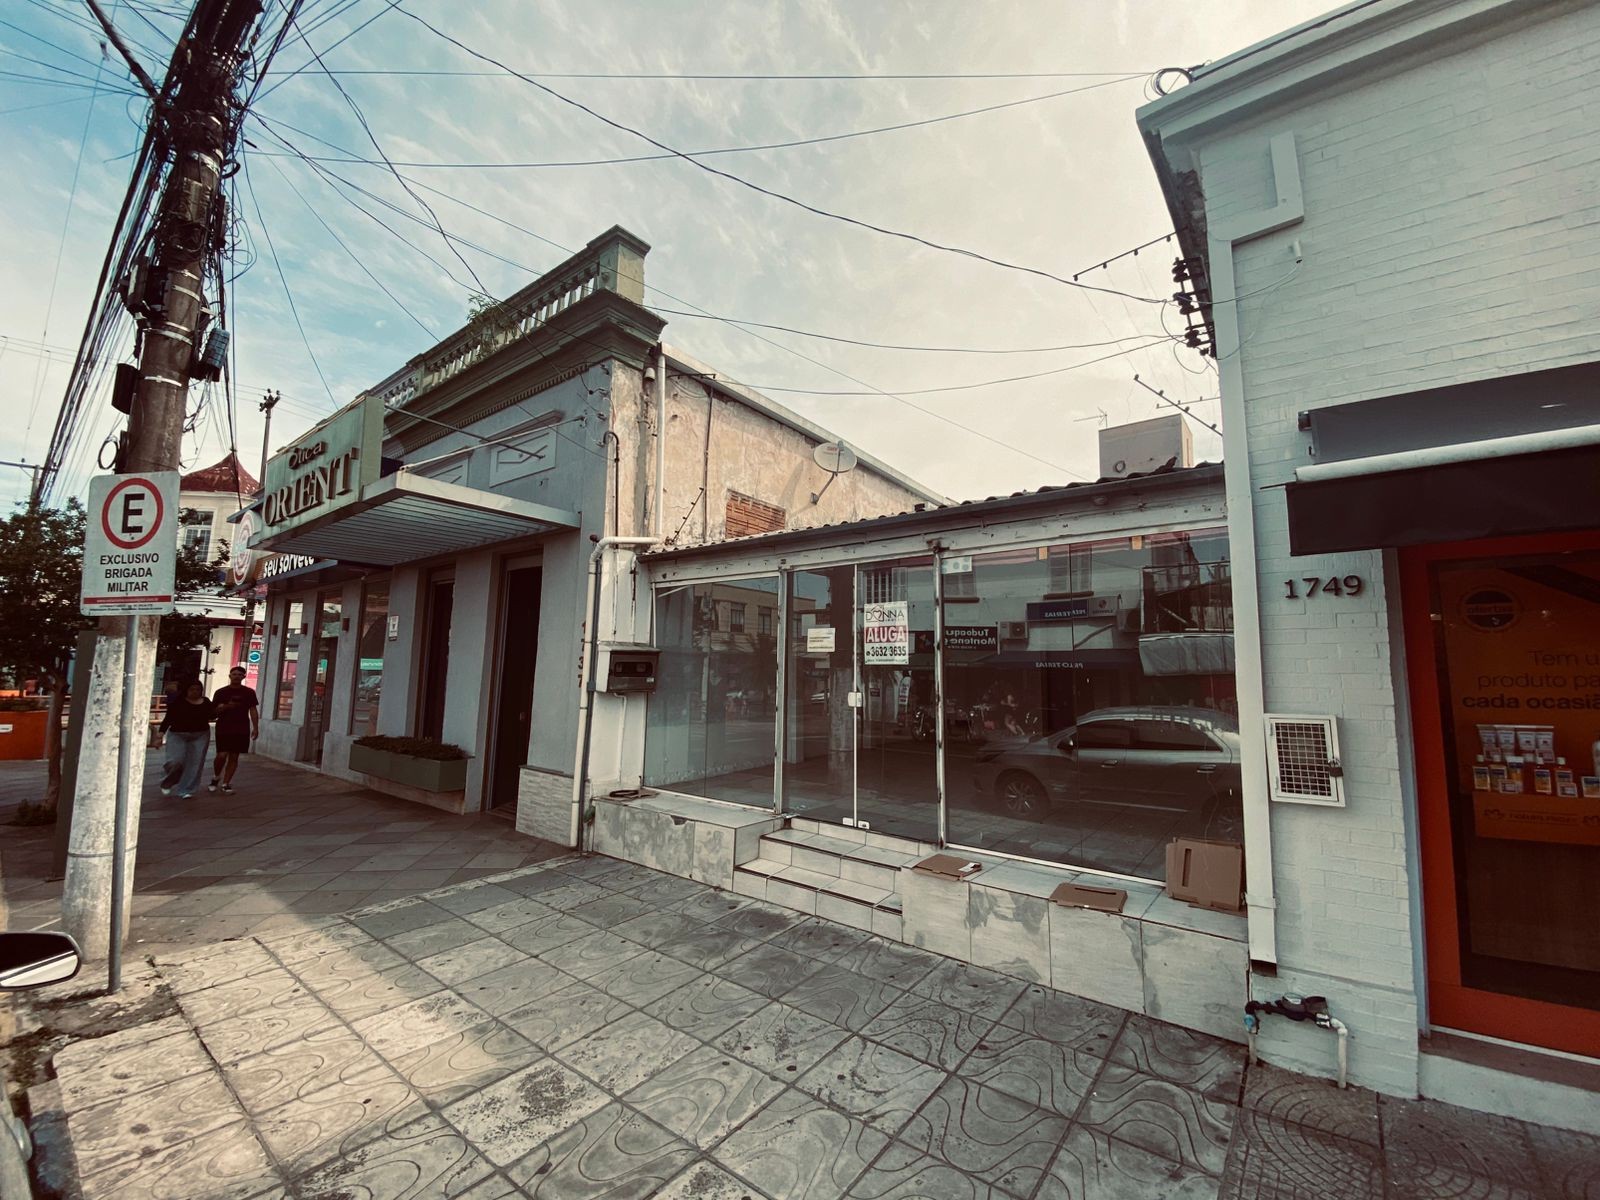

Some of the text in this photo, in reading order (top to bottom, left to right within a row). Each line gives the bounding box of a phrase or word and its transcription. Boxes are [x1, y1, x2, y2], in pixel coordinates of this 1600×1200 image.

[262, 447, 359, 527] ORIENT
[121, 493, 145, 534] E
[100, 553, 159, 565] EXCLUSIVO
[105, 567, 153, 579] BRIGADA
[263, 557, 278, 578] seu
[107, 581, 149, 593] MILITAR
[1284, 575, 1364, 599] 1749
[866, 626, 906, 643] ALUGA
[871, 646, 907, 657] 3632 3635
[1528, 650, 1578, 666] Tem
[1478, 673, 1568, 691] produto
[1462, 693, 1520, 709] cada
